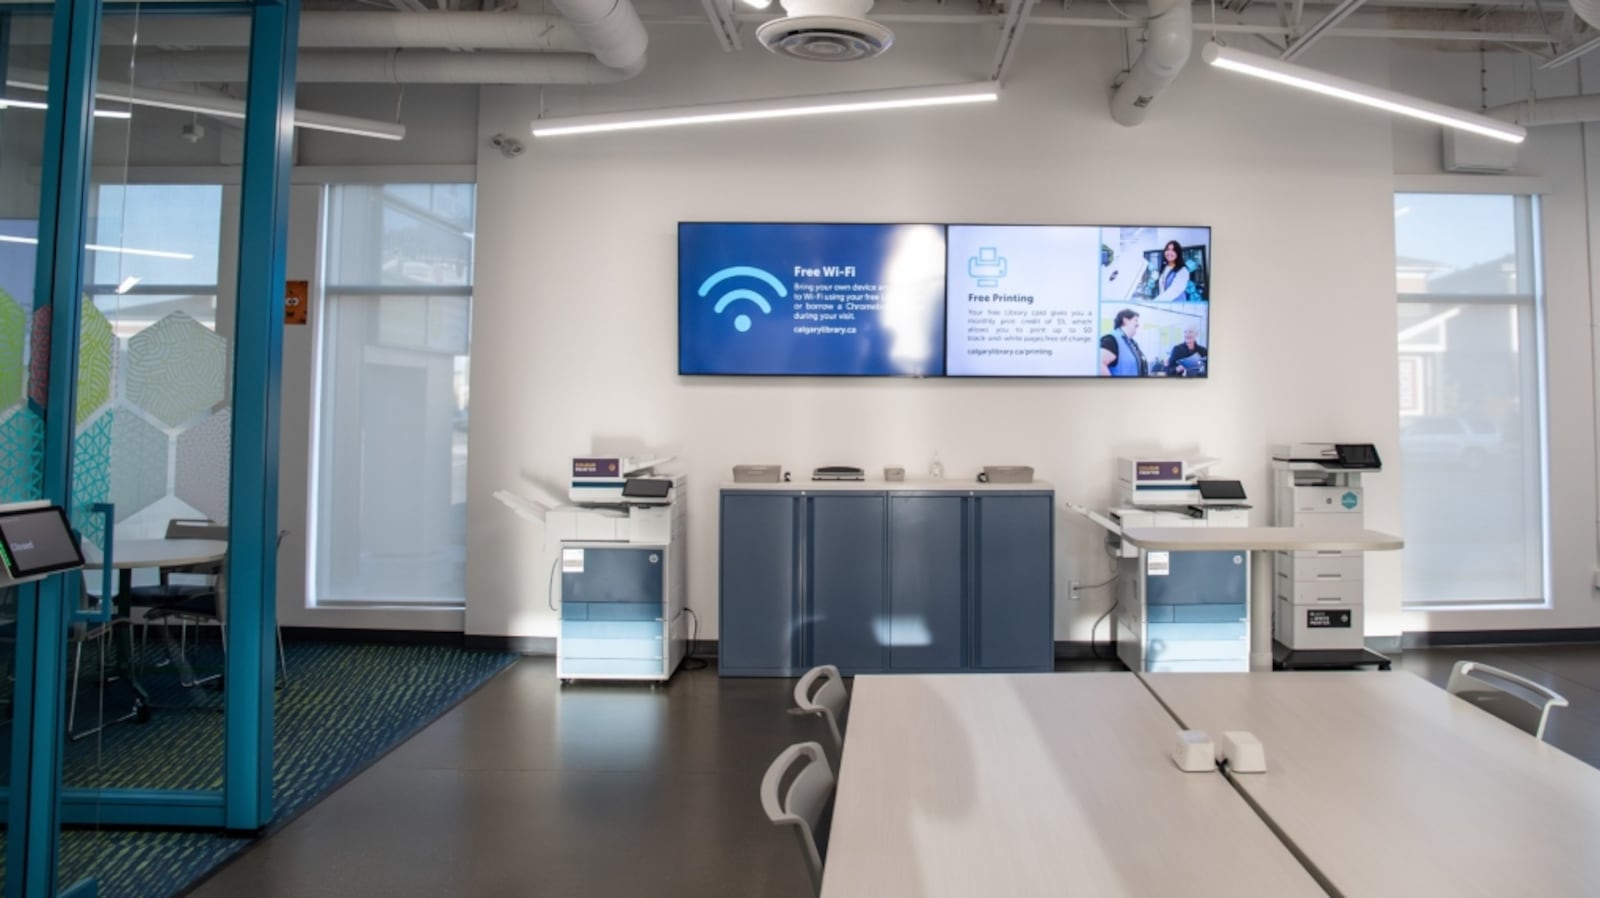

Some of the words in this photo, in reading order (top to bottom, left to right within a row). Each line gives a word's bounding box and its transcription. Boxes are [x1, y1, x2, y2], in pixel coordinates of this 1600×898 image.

[794, 266, 820, 277] Free
[822, 266, 856, 277] Wi-Fi
[794, 283, 814, 292] Bring
[852, 283, 876, 291] device
[824, 293, 844, 301] using
[968, 293, 990, 302] Free
[993, 293, 1034, 304] Printing
[793, 312, 818, 321] during
[793, 326, 856, 335] calgarylibrary.ca
